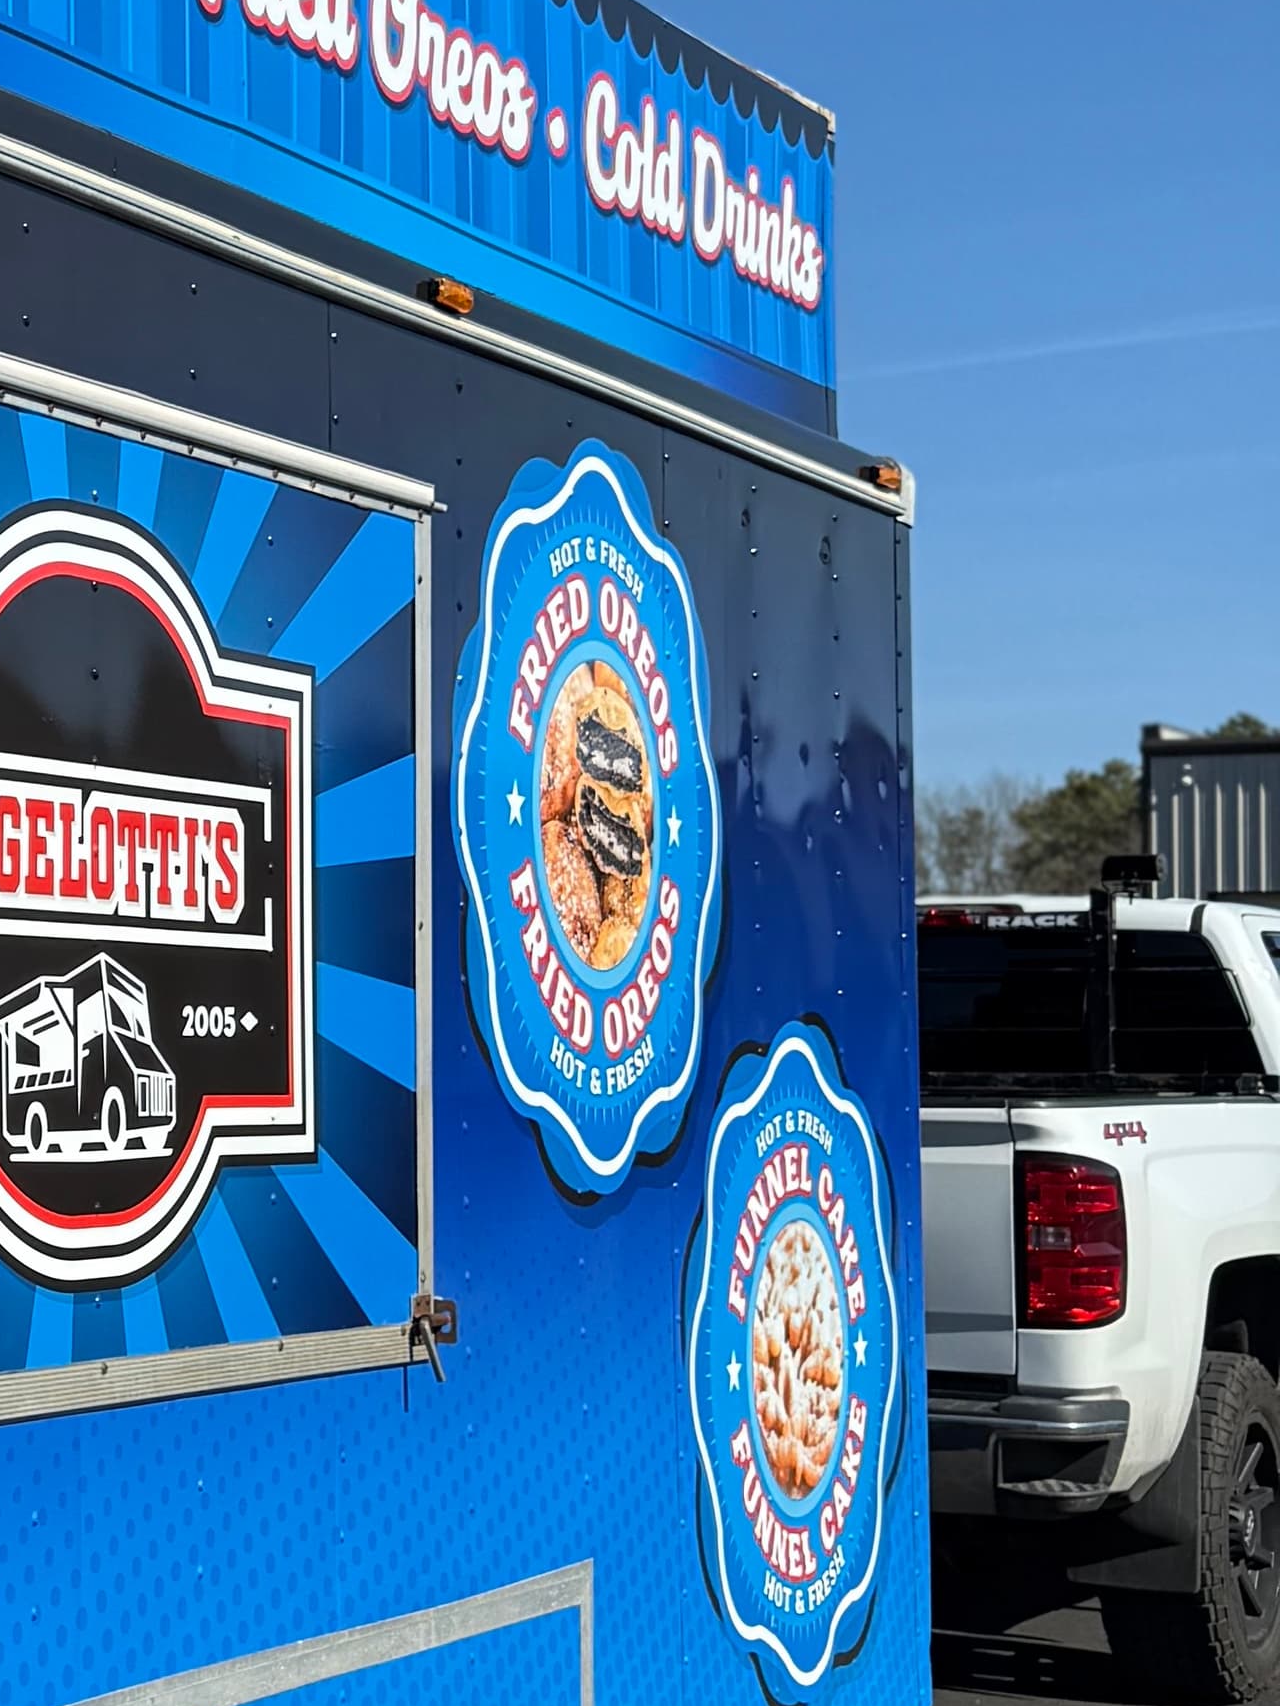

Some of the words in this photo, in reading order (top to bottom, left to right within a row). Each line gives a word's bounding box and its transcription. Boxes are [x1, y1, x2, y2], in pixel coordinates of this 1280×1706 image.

[584, 73, 686, 242] Cold
[693, 128, 824, 310] Drinks
[550, 539, 582, 579] HOT
[584, 538, 597, 563] &
[599, 540, 644, 604] FRESH
[508, 574, 591, 753] FRIED
[599, 575, 678, 778] OREOS
[181, 1005, 237, 1038] 2005
[508, 858, 594, 1054] FRIED
[602, 875, 680, 1060] OREOS
[550, 1033, 587, 1092] HOT
[589, 1070, 602, 1097] &
[605, 1037, 655, 1096] FRESH
[756, 1117, 782, 1159] HOT
[784, 1110, 795, 1136] &
[797, 1109, 833, 1156] FRESH
[727, 1143, 813, 1323] FUNNEL
[816, 1158, 866, 1323] CAKE
[731, 1420, 816, 1583] FUNNEL
[818, 1395, 868, 1555] CAKE
[763, 1568, 792, 1613] HOT
[794, 1589, 807, 1616] &
[808, 1543, 846, 1612] FRESH
